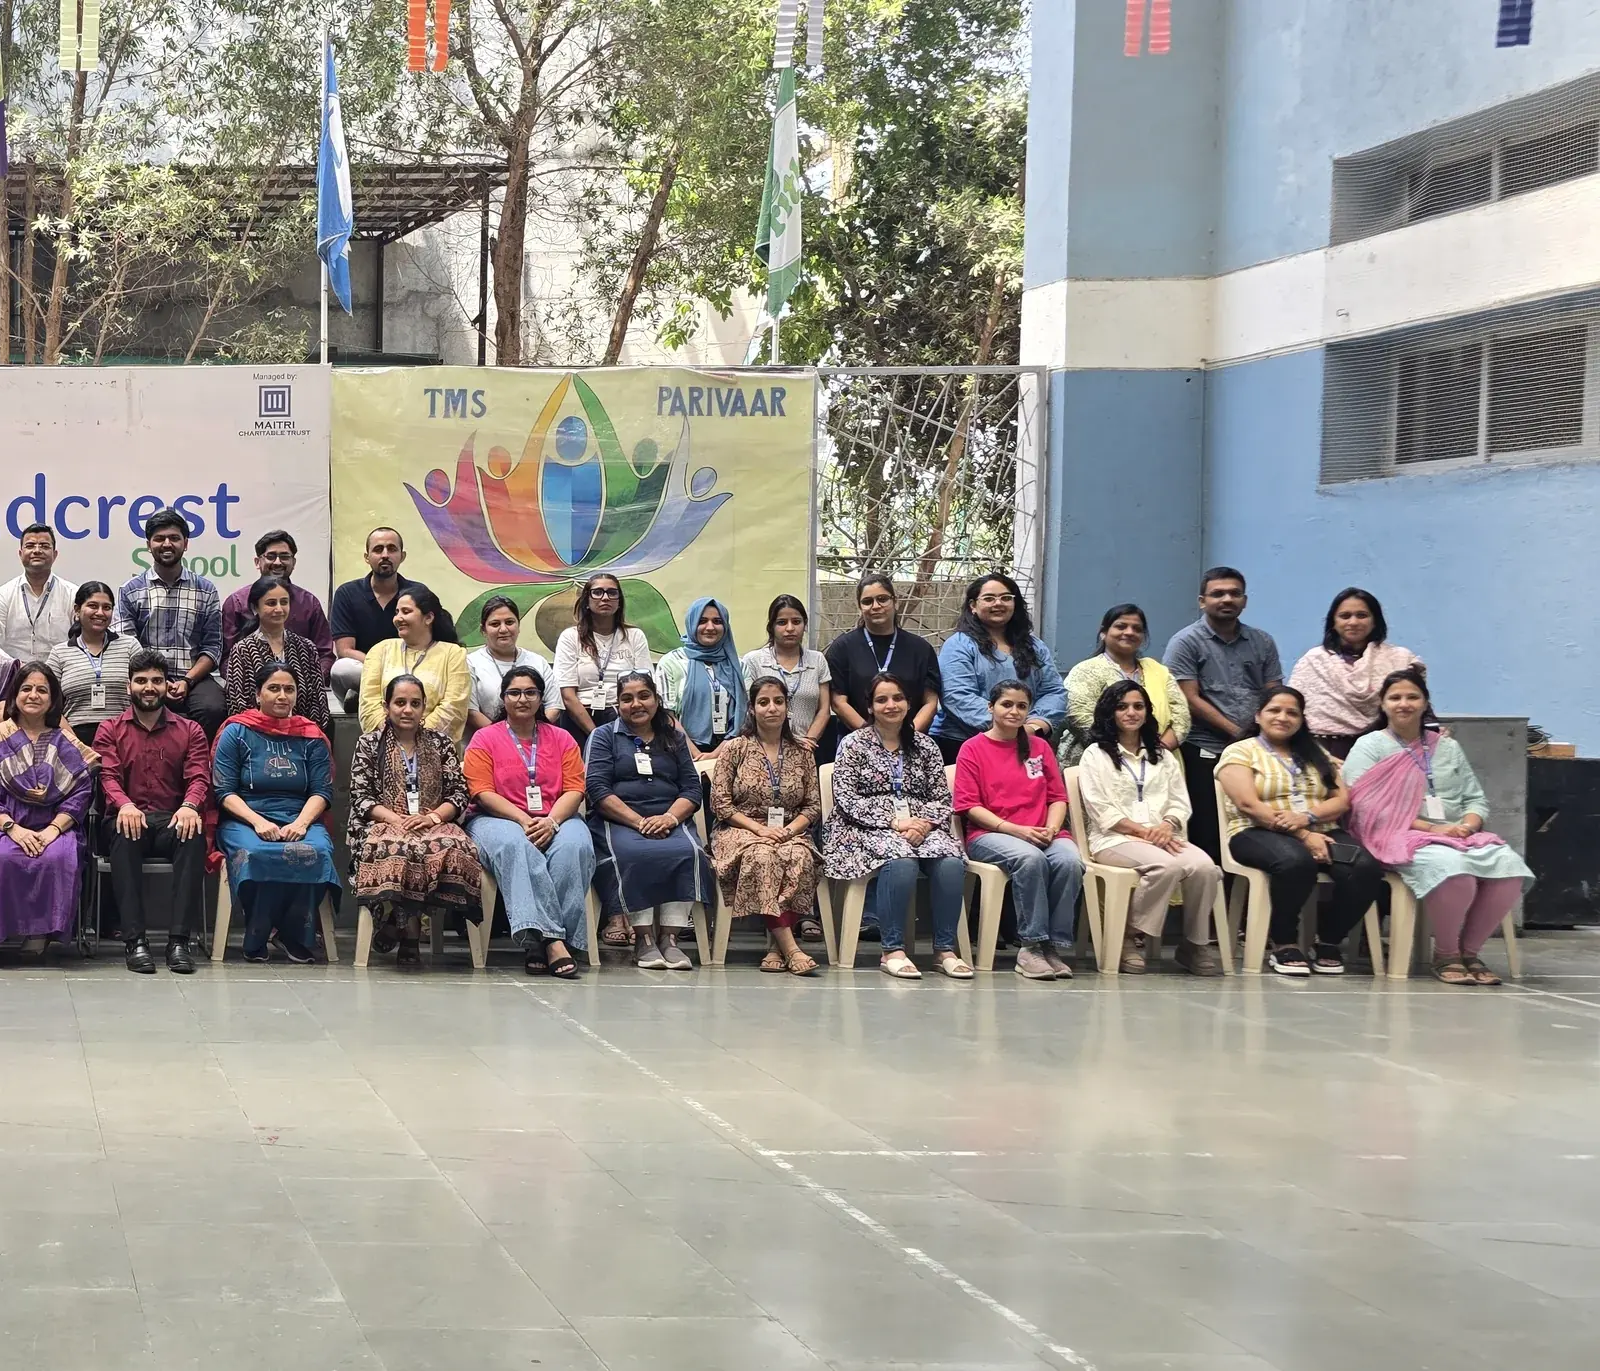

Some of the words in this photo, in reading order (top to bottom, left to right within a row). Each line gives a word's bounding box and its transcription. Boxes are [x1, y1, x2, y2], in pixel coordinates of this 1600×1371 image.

[253, 373, 285, 381] Managed
[424, 388, 487, 418] TMS
[657, 386, 787, 417] PARIVAAR
[254, 421, 295, 429] MAITRI
[131, 544, 241, 578] Sool
